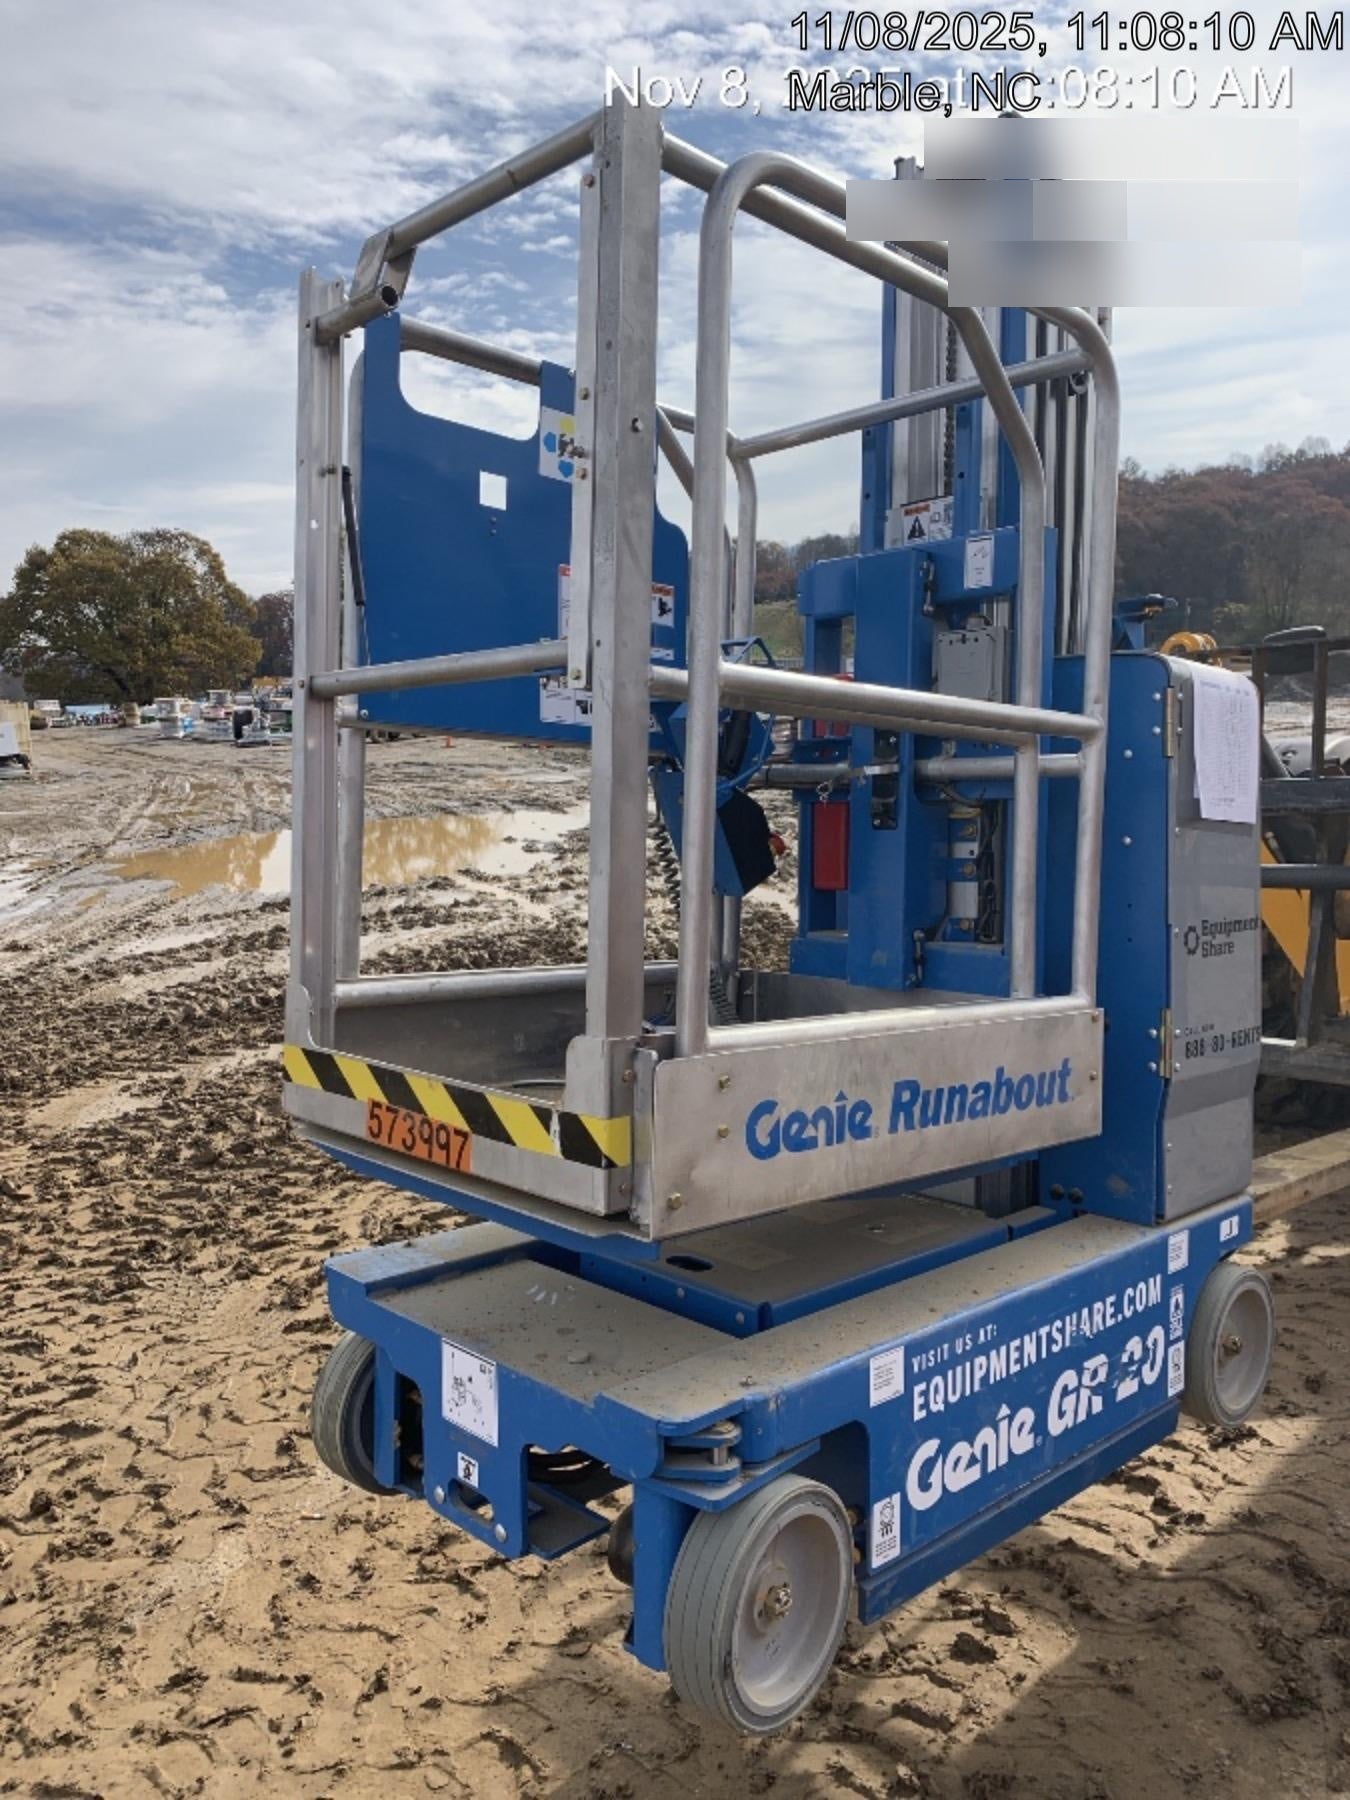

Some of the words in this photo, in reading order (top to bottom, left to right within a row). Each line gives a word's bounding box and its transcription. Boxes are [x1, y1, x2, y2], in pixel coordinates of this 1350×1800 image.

[1201, 940, 1235, 958] Share
[888, 1057, 1073, 1134] Runabout
[368, 1100, 468, 1169] 573997
[911, 1343, 949, 1374] VISIT
[955, 1333, 973, 1354] US
[977, 1323, 998, 1345] AT:
[912, 1273, 1163, 1423] EQUIPMENTSHARE.COM
